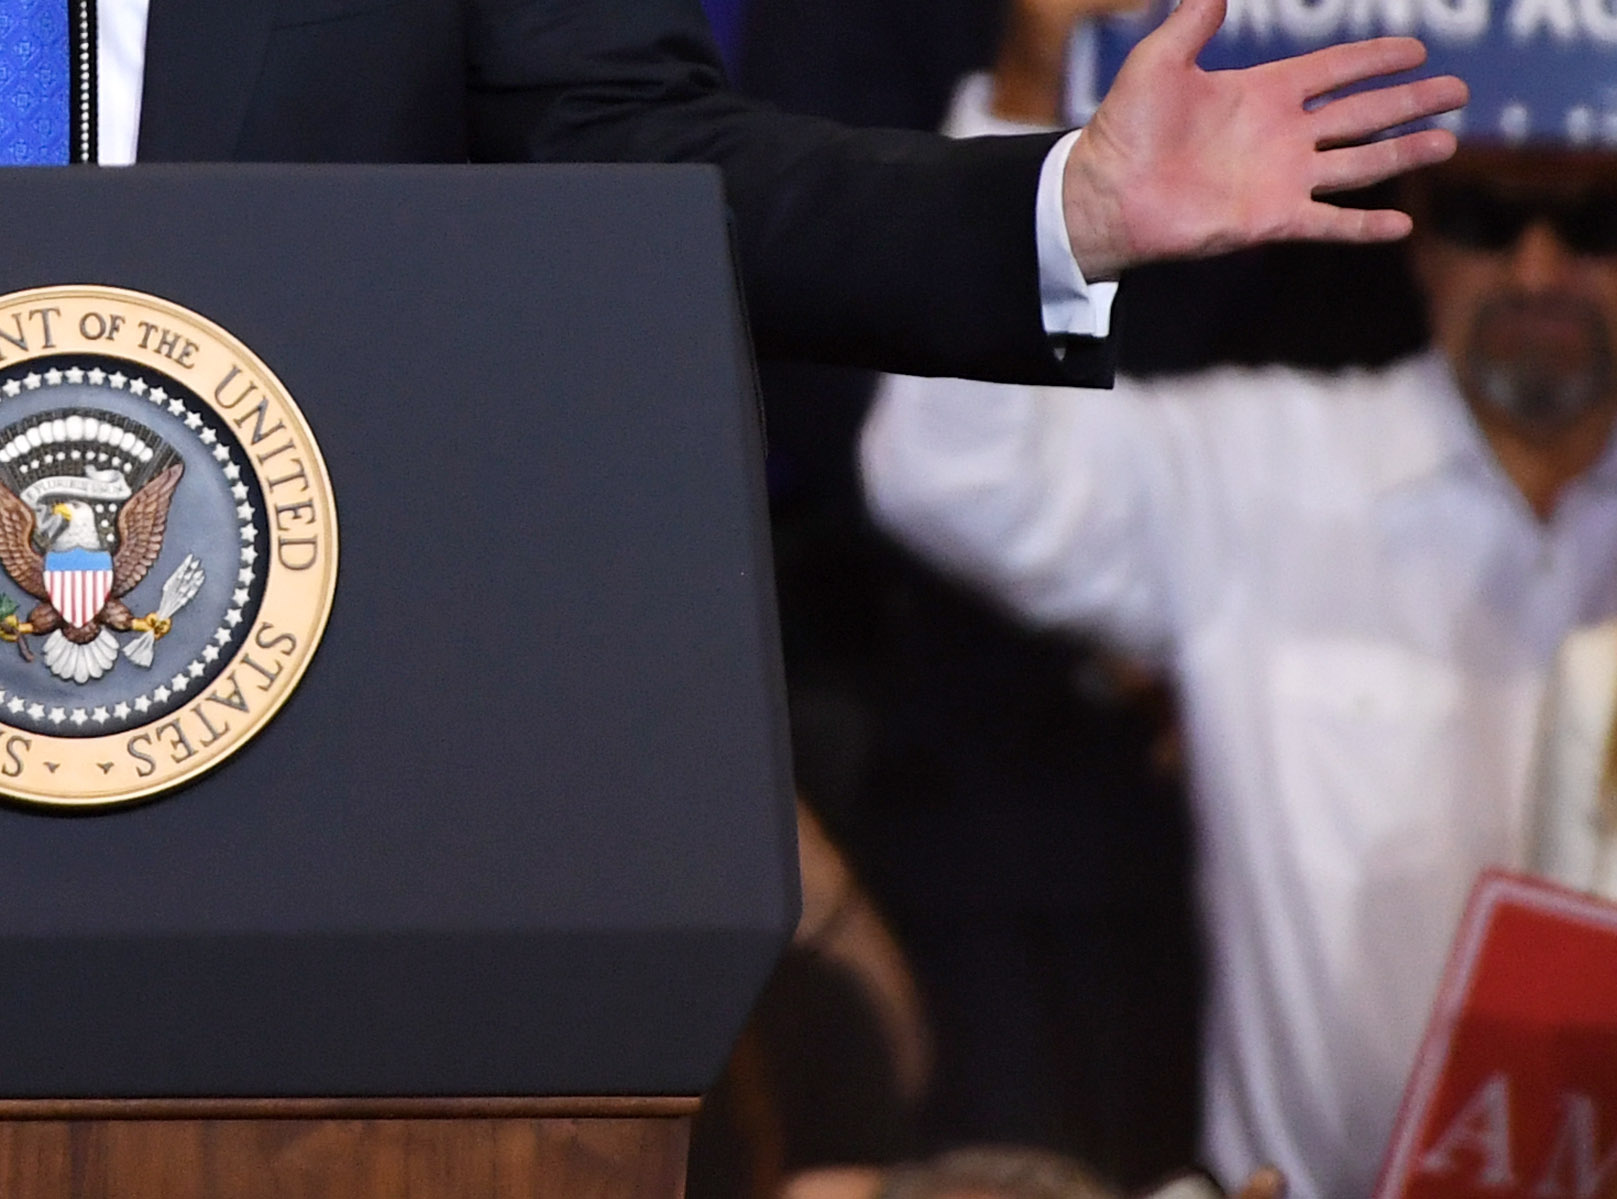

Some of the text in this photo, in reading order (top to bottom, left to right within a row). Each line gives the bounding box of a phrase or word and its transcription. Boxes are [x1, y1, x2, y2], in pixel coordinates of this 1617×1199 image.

[78, 311, 126, 343] OF
[137, 320, 200, 369] THE
[214, 365, 319, 572] UNITED
[127, 621, 298, 779] STATES
